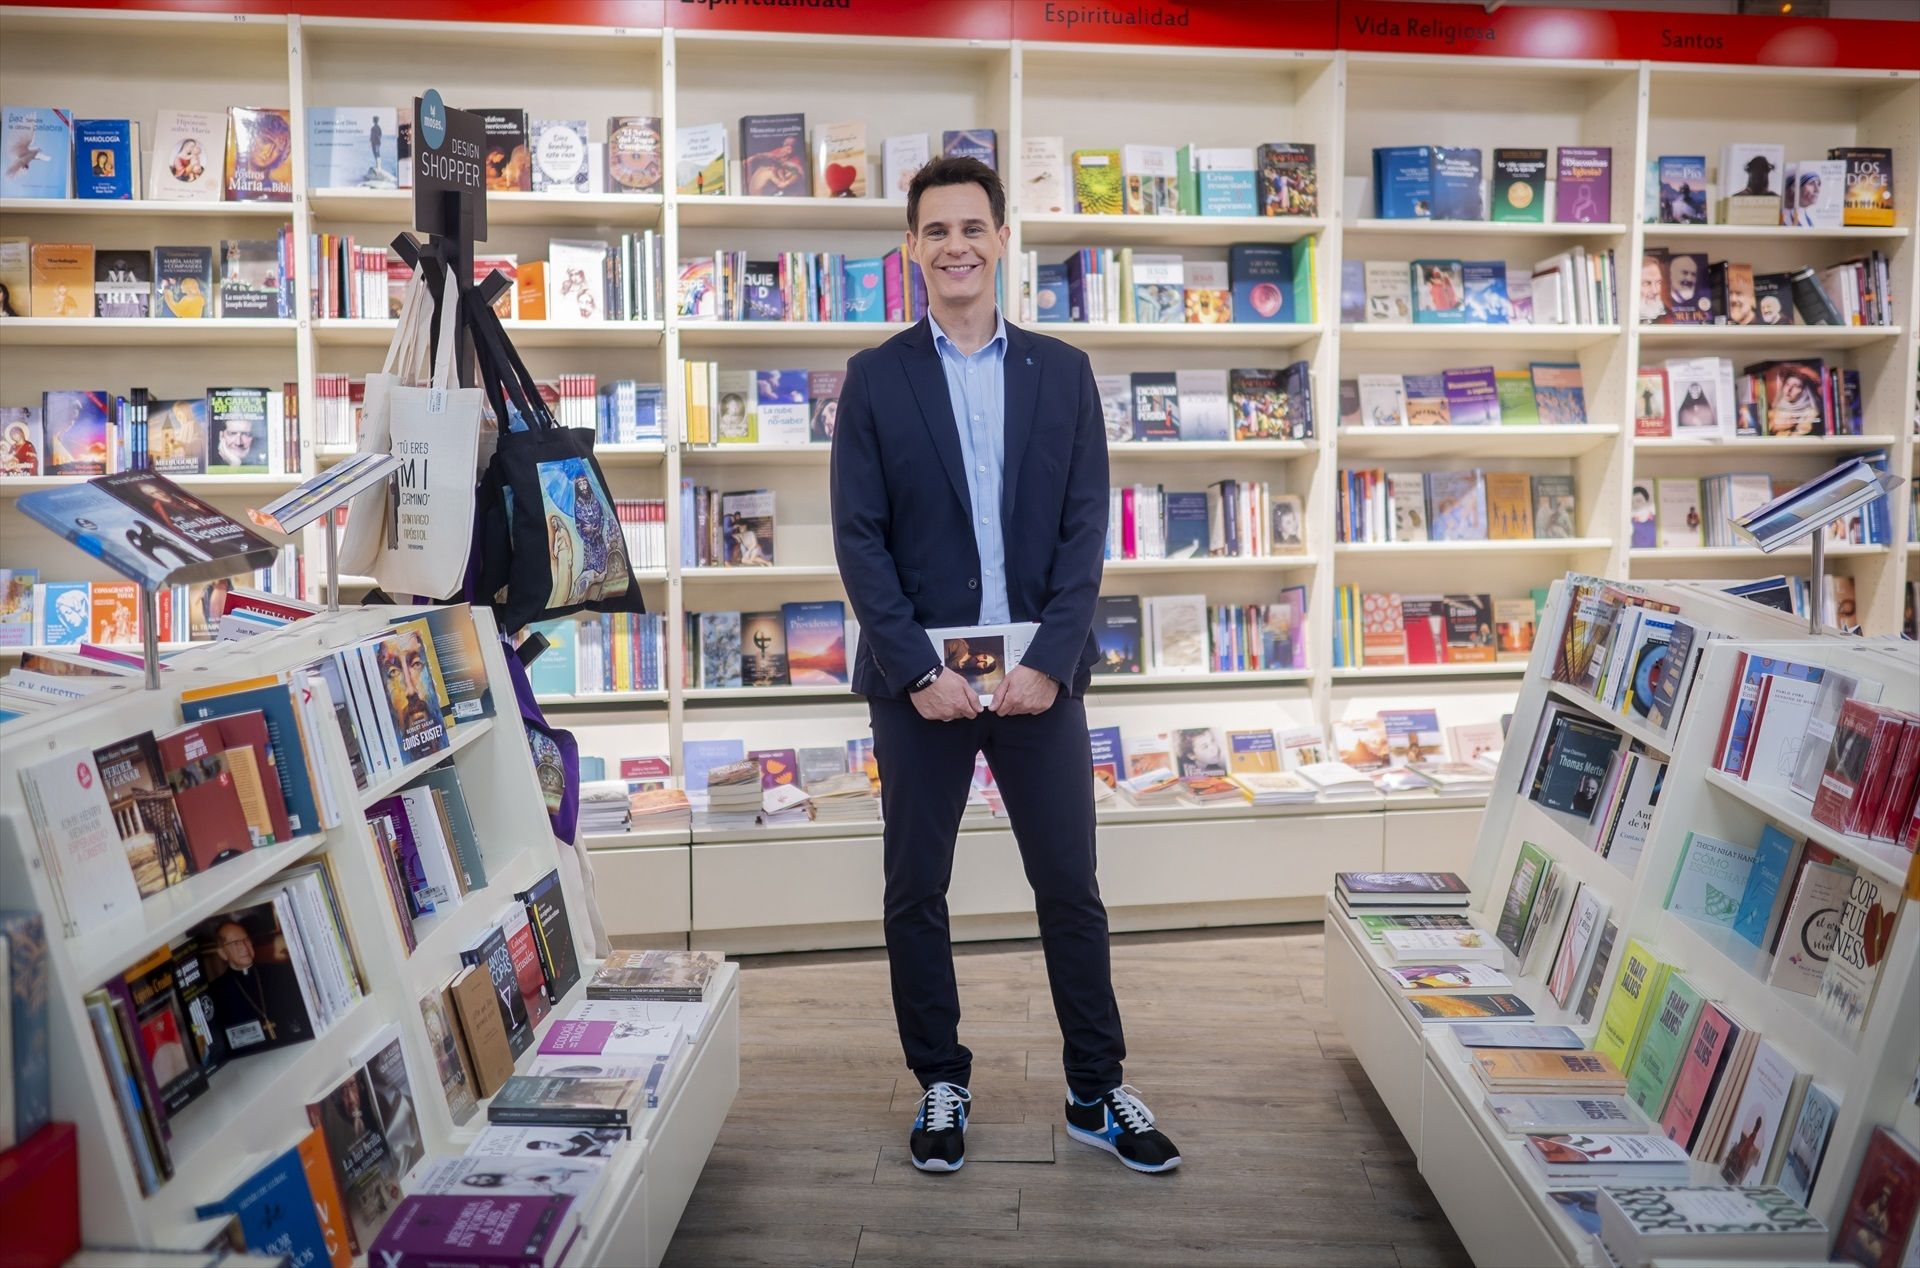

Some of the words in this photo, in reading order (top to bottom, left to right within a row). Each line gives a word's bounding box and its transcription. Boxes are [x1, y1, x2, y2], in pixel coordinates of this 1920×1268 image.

[233, 15, 247, 23] 515
[1044, 3, 1190, 28] Espiritualidad
[1355, 16, 1401, 37] Vida
[1407, 18, 1496, 44] Religiosa
[1661, 28, 1723, 49] Santos
[424, 116, 443, 131] moses.
[84, 135, 120, 143] MARIOLOGÍA
[451, 138, 480, 159] DESIGN
[421, 151, 480, 188] SHOPPER
[1854, 162, 1880, 174] LOS
[1847, 173, 1888, 187] DOCE
[109, 270, 137, 283] MA
[1136, 387, 1177, 396] ENCONTRAR
[212, 397, 222, 406] LA
[214, 405, 224, 413] DE
[238, 405, 265, 413] VIDA
[411, 443, 429, 454] ERES
[402, 514, 430, 526] SANTIAGO
[187, 524, 244, 542] Newman
[93, 586, 135, 594] CONSAGRACIÓN
[790, 620, 839, 631] Providencia
[403, 733, 420, 752] ¿DIOS
[420, 725, 443, 745] EXISTE?
[102, 761, 133, 777] PERDER
[1559, 754, 1583, 772] Thomas
[1584, 762, 1604, 777] Merto
[1628, 818, 1640, 829] de
[1635, 809, 1652, 820] Ant
[1696, 841, 1716, 855] THICH
[1716, 847, 1736, 859] NHAT
[1692, 852, 1729, 870] CÓMO
[1850, 875, 1878, 908] COR
[1816, 919, 1826, 930] el
[1841, 901, 1866, 937] FUL
[488, 943, 509, 973] ANTOS
[1833, 928, 1866, 970] NESS
[491, 961, 513, 987] COPAS
[1627, 956, 1647, 977] FRANZ
[1621, 974, 1642, 1000] JALICS
[1667, 989, 1690, 1018] FRANZ
[1660, 1006, 1683, 1036] JALICS
[552, 1022, 576, 1050] ECOLOGÍA
[342, 1159, 354, 1172] La
[363, 1133, 382, 1153] brilla
[444, 1202, 481, 1245] MEMORIA
[487, 1202, 522, 1246] ESCRITOS
